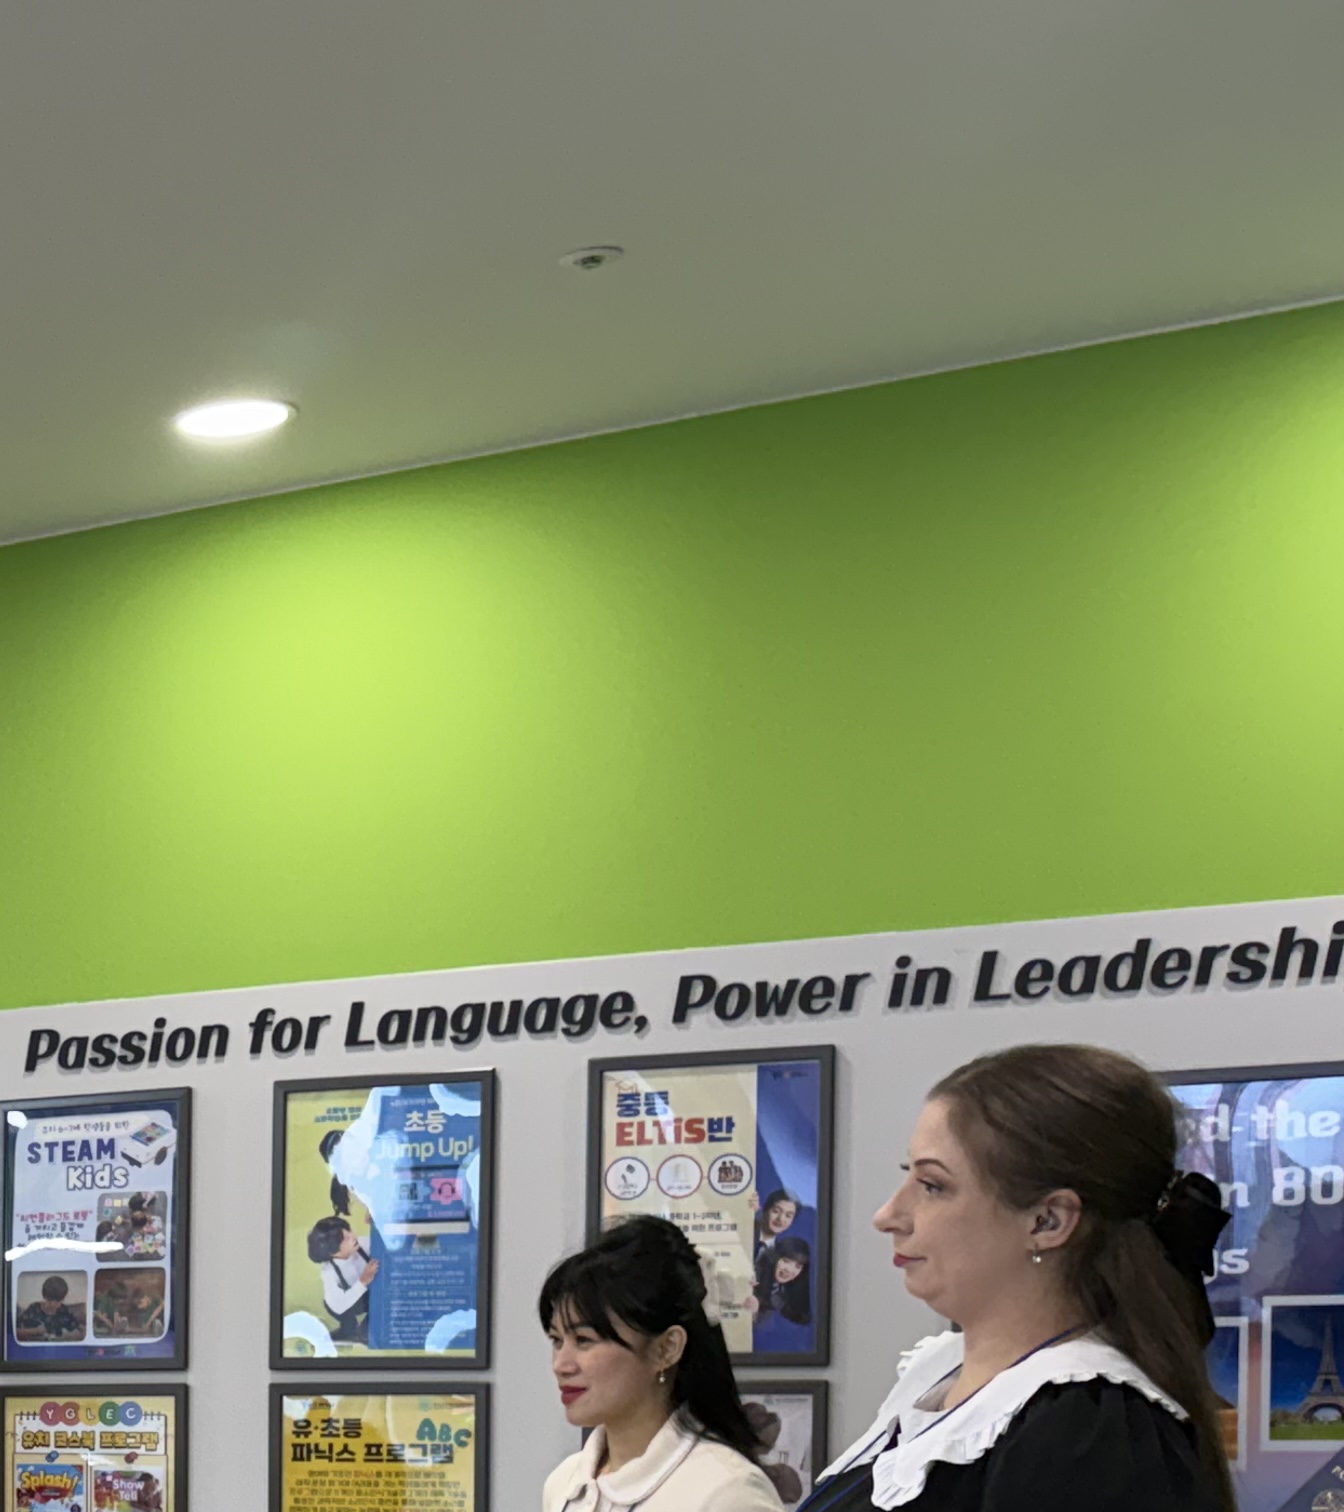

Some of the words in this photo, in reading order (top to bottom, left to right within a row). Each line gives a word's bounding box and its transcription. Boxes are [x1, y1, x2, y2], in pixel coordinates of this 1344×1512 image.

[23, 1017, 230, 1073] Passion
[249, 1008, 331, 1055] for
[345, 990, 649, 1046] Language,
[672, 974, 872, 1023] Power
[887, 956, 952, 1008] in
[616, 1090, 670, 1118] 중등
[404, 1110, 447, 1134] 초등
[27, 1138, 116, 1164] STEAM
[438, 1135, 474, 1161] Up!
[67, 1164, 129, 1191] Kids
[1272, 1165, 1344, 1206] 80
[22, 1431, 50, 1449] 유치
[54, 1431, 95, 1451] 코스북
[100, 1431, 159, 1451] 프로그램
[291, 1443, 356, 1463] 파닉스
[363, 1443, 454, 1464] 프로그램
[20, 1470, 79, 1490] Splash!
[113, 1479, 144, 1489] Show
